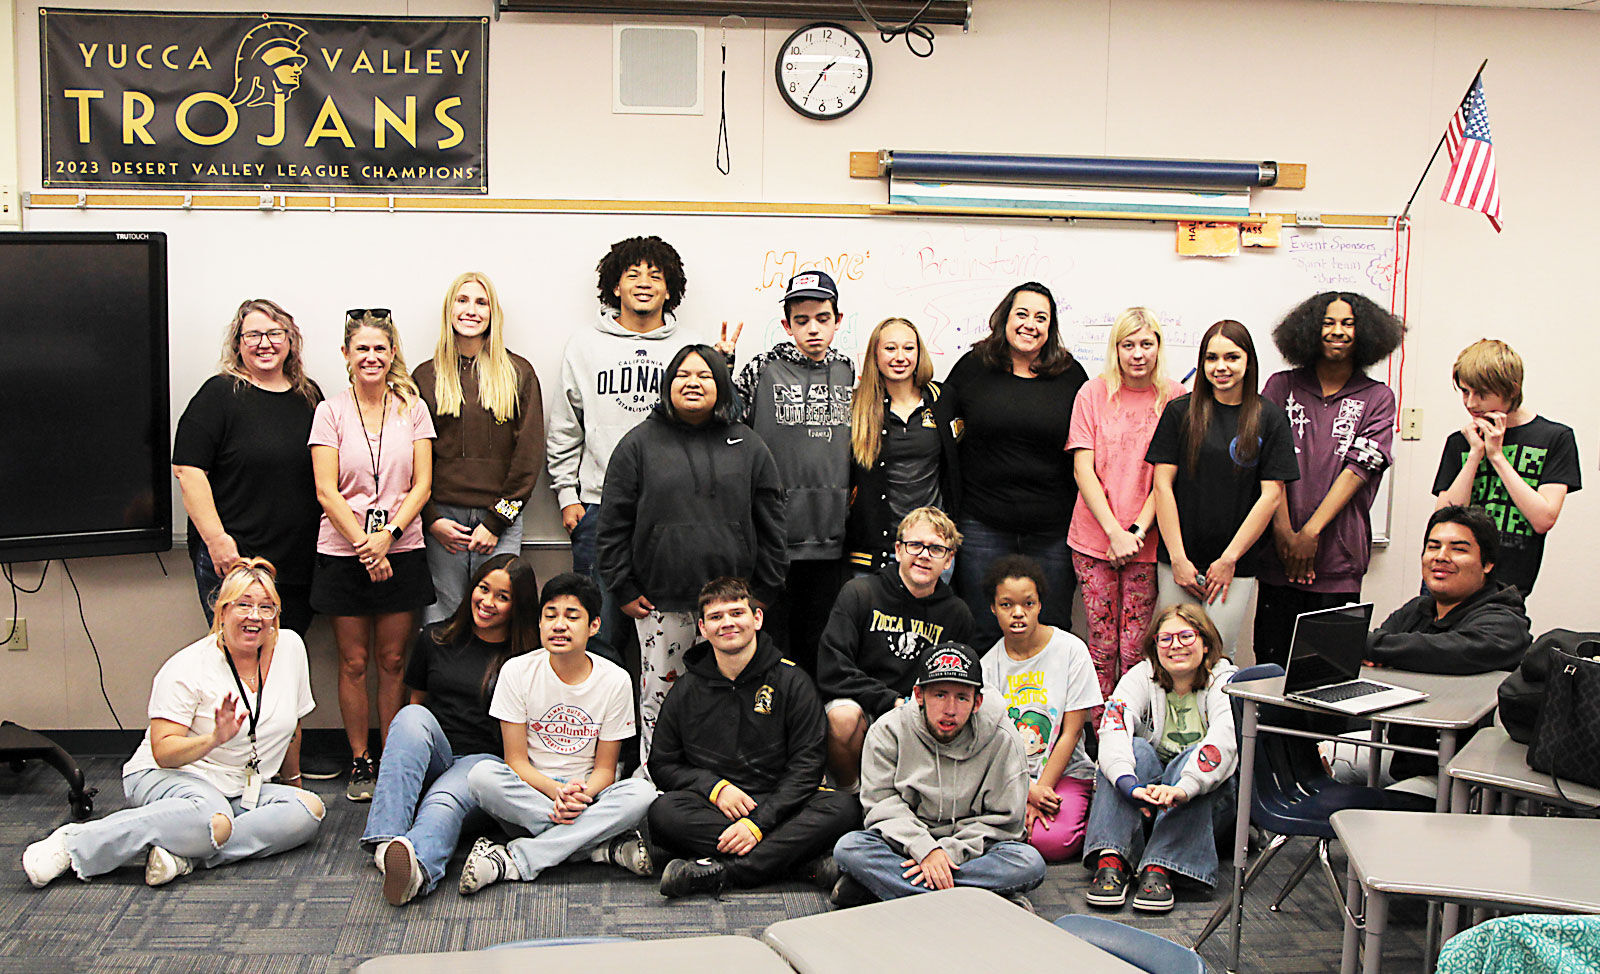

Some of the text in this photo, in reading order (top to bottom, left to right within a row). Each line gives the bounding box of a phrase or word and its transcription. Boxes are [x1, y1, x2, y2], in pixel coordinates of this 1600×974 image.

[805, 33, 812, 42] 11
[823, 29, 833, 39] 12
[791, 46, 800, 55] 10
[854, 49, 861, 58] 2
[78, 43, 470, 75] YUCCA VALLEY
[856, 68, 863, 79] 3
[789, 82, 796, 92] 8
[849, 85, 856, 95] 4
[803, 97, 808, 106] 7
[818, 102, 826, 112] 6
[837, 99, 843, 109] 5
[64, 89, 465, 150] TROJANS
[56, 161, 474, 180] 2023 DESERT VALLEY LEAGUE CHAMPIONS
[1188, 221, 1197, 241] HAL
[1241, 226, 1263, 235] PASS
[1289, 234, 1376, 252] Event Sponsors
[618, 358, 663, 367] CALIFORNIA
[597, 366, 632, 395] OLD
[633, 394, 645, 403] 94
[773, 384, 853, 403] NAU
[615, 397, 654, 413] ESTABLISHED
[869, 609, 944, 646] YUCCA VALLEY
[1006, 671, 1045, 693] Lucky
[547, 706, 564, 719] ALWAY
[544, 723, 600, 737] Columbia
